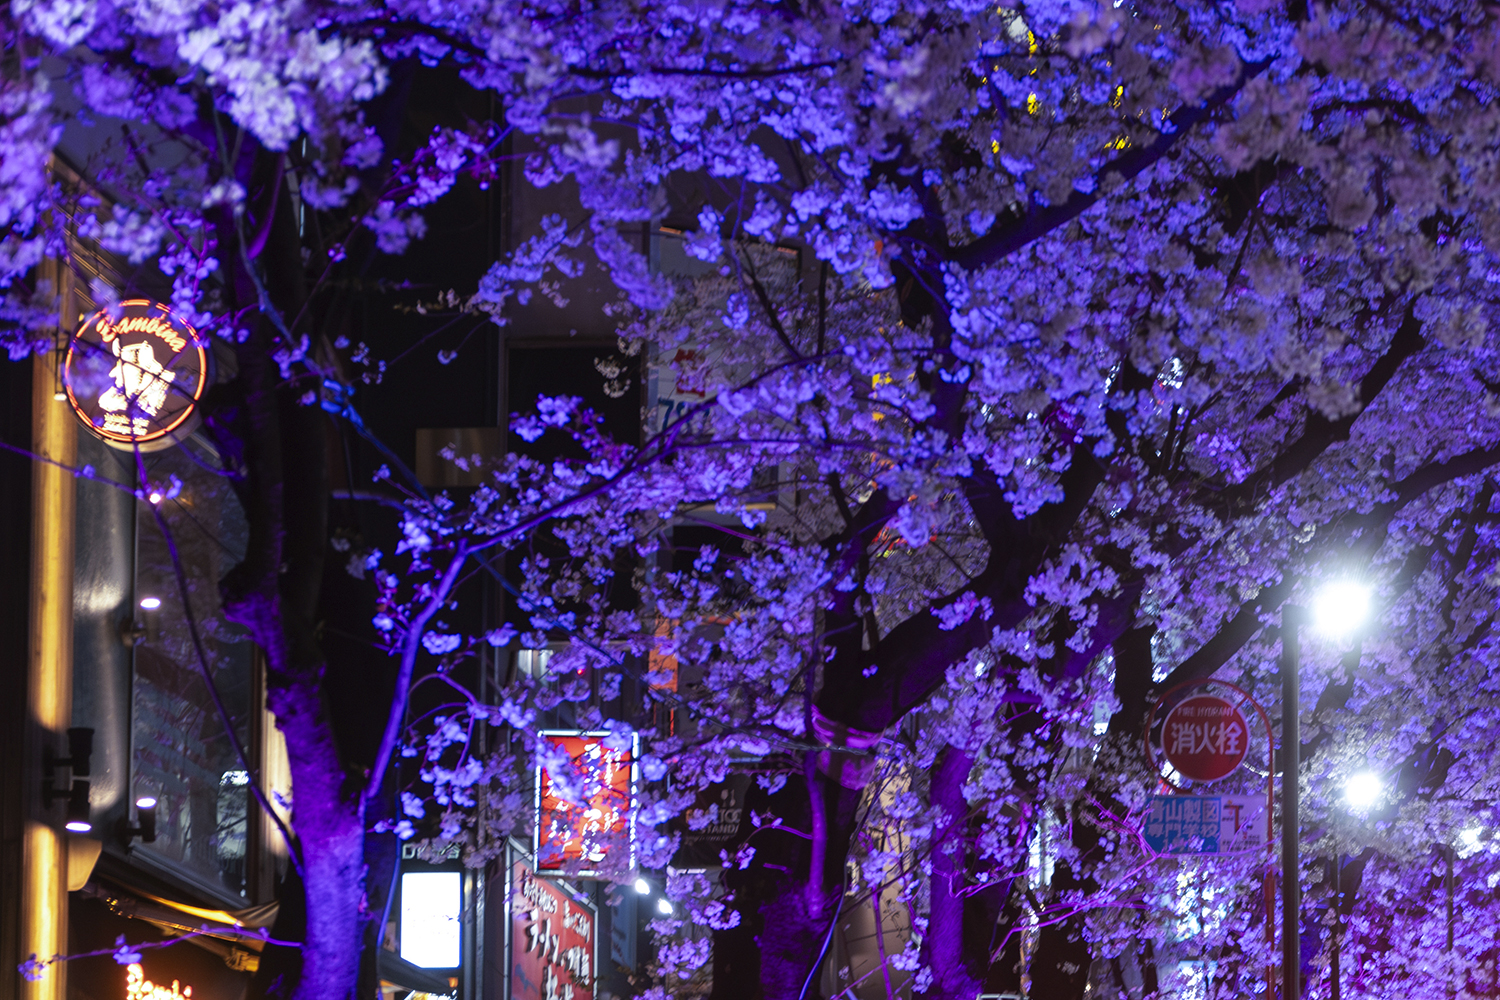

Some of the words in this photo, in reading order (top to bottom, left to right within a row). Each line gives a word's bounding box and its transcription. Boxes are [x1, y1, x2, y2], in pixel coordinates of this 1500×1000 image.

[96, 314, 187, 352] Bambina
[1177, 707, 1195, 717] FIRE
[1197, 706, 1234, 718] HYDRANT
[1170, 721, 1243, 755] 消火栓
